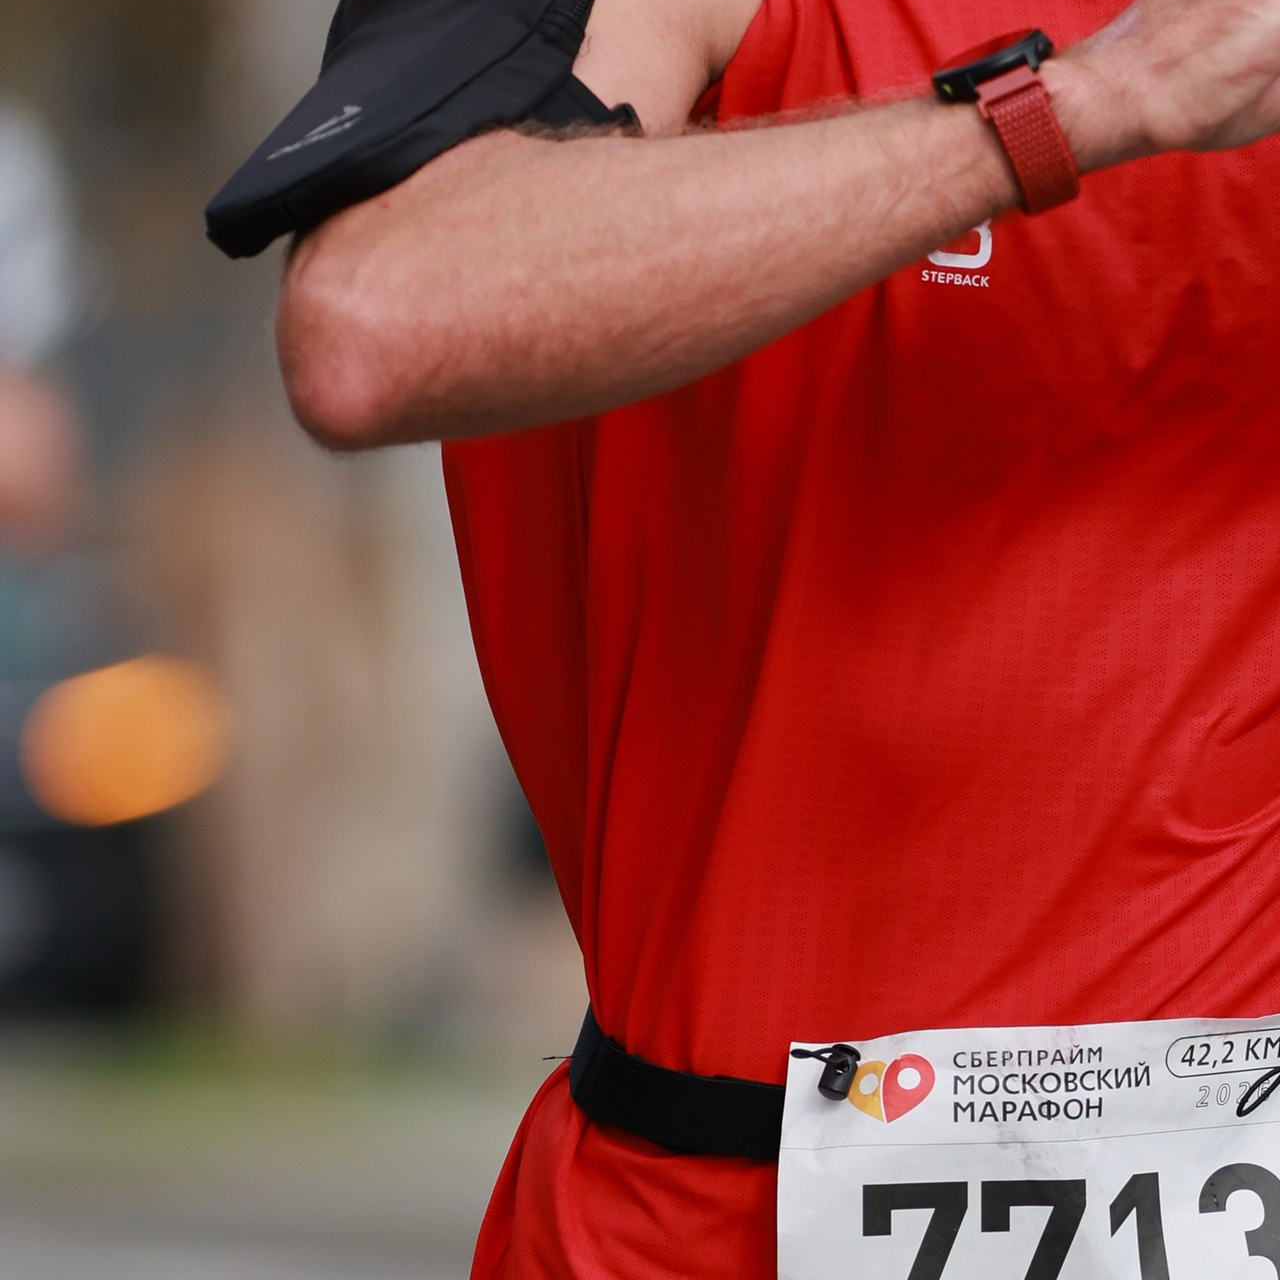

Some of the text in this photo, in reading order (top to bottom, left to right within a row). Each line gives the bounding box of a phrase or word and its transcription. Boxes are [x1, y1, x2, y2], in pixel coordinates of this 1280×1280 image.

[921, 269, 990, 287] STEPBACK
[953, 1045, 1102, 1068] СБЕРПРАЙМ
[1180, 1040, 1235, 1069] 42,2
[953, 1061, 1150, 1095] МОСКОВСКИЙ
[953, 1097, 1102, 1123] МАРАФОН
